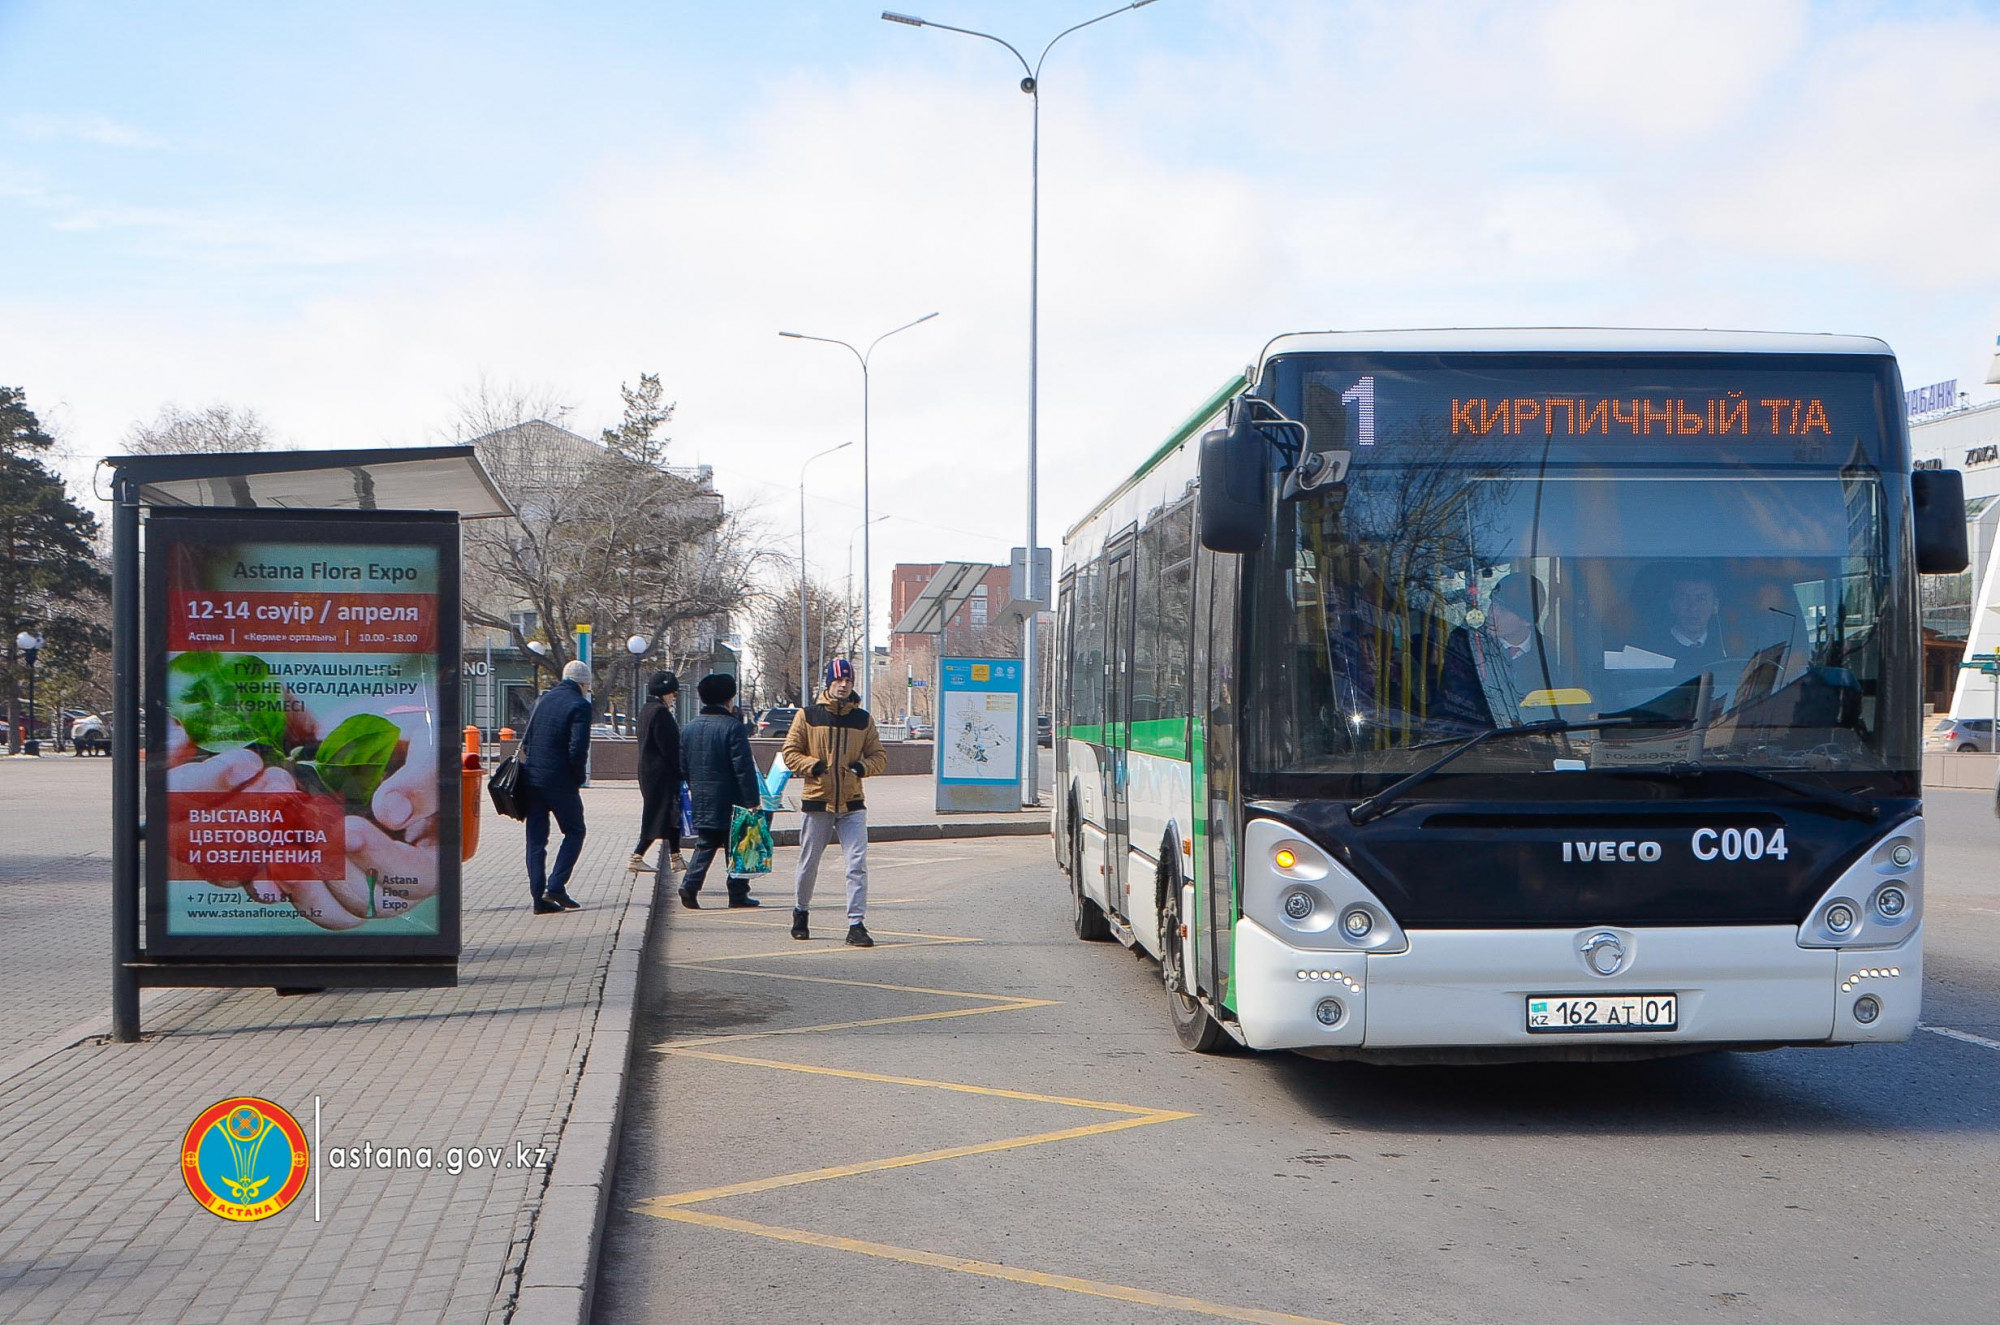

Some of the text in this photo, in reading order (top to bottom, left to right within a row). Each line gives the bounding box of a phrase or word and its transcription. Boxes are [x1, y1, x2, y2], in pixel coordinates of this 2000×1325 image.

[1341, 376, 1375, 446] 1
[1452, 390, 1750, 435] КИРПИЧНЫЙ
[233, 562, 417, 584] Astana Flora Expo
[188, 600, 250, 620] 12-14
[256, 602, 314, 625] сәуір
[337, 606, 419, 625] апреля
[188, 631, 224, 642] Астана
[359, 633, 385, 643] 10.00
[392, 633, 418, 643] 18.00
[234, 681, 418, 697] ЖӘНЕ КӨГАЛДАНДЫРУ
[189, 809, 284, 824] ВЫСТАВКА
[189, 829, 328, 847] ЦВЕТОВОДСТВА
[1691, 828, 1789, 861] C004
[189, 850, 322, 864] И ОЗЕЛЕНЕНИЯ
[1562, 841, 1662, 862] IVECO
[382, 875, 419, 885] Astana
[207, 892, 242, 905] (7172)
[262, 893, 276, 903] 81
[382, 887, 409, 897] Flora
[382, 899, 408, 911] Expo
[187, 908, 323, 920] www.astanaflorexpo.kz
[1555, 1000, 1673, 1025] 162 AT 01
[1531, 1015, 1549, 1026] KZ
